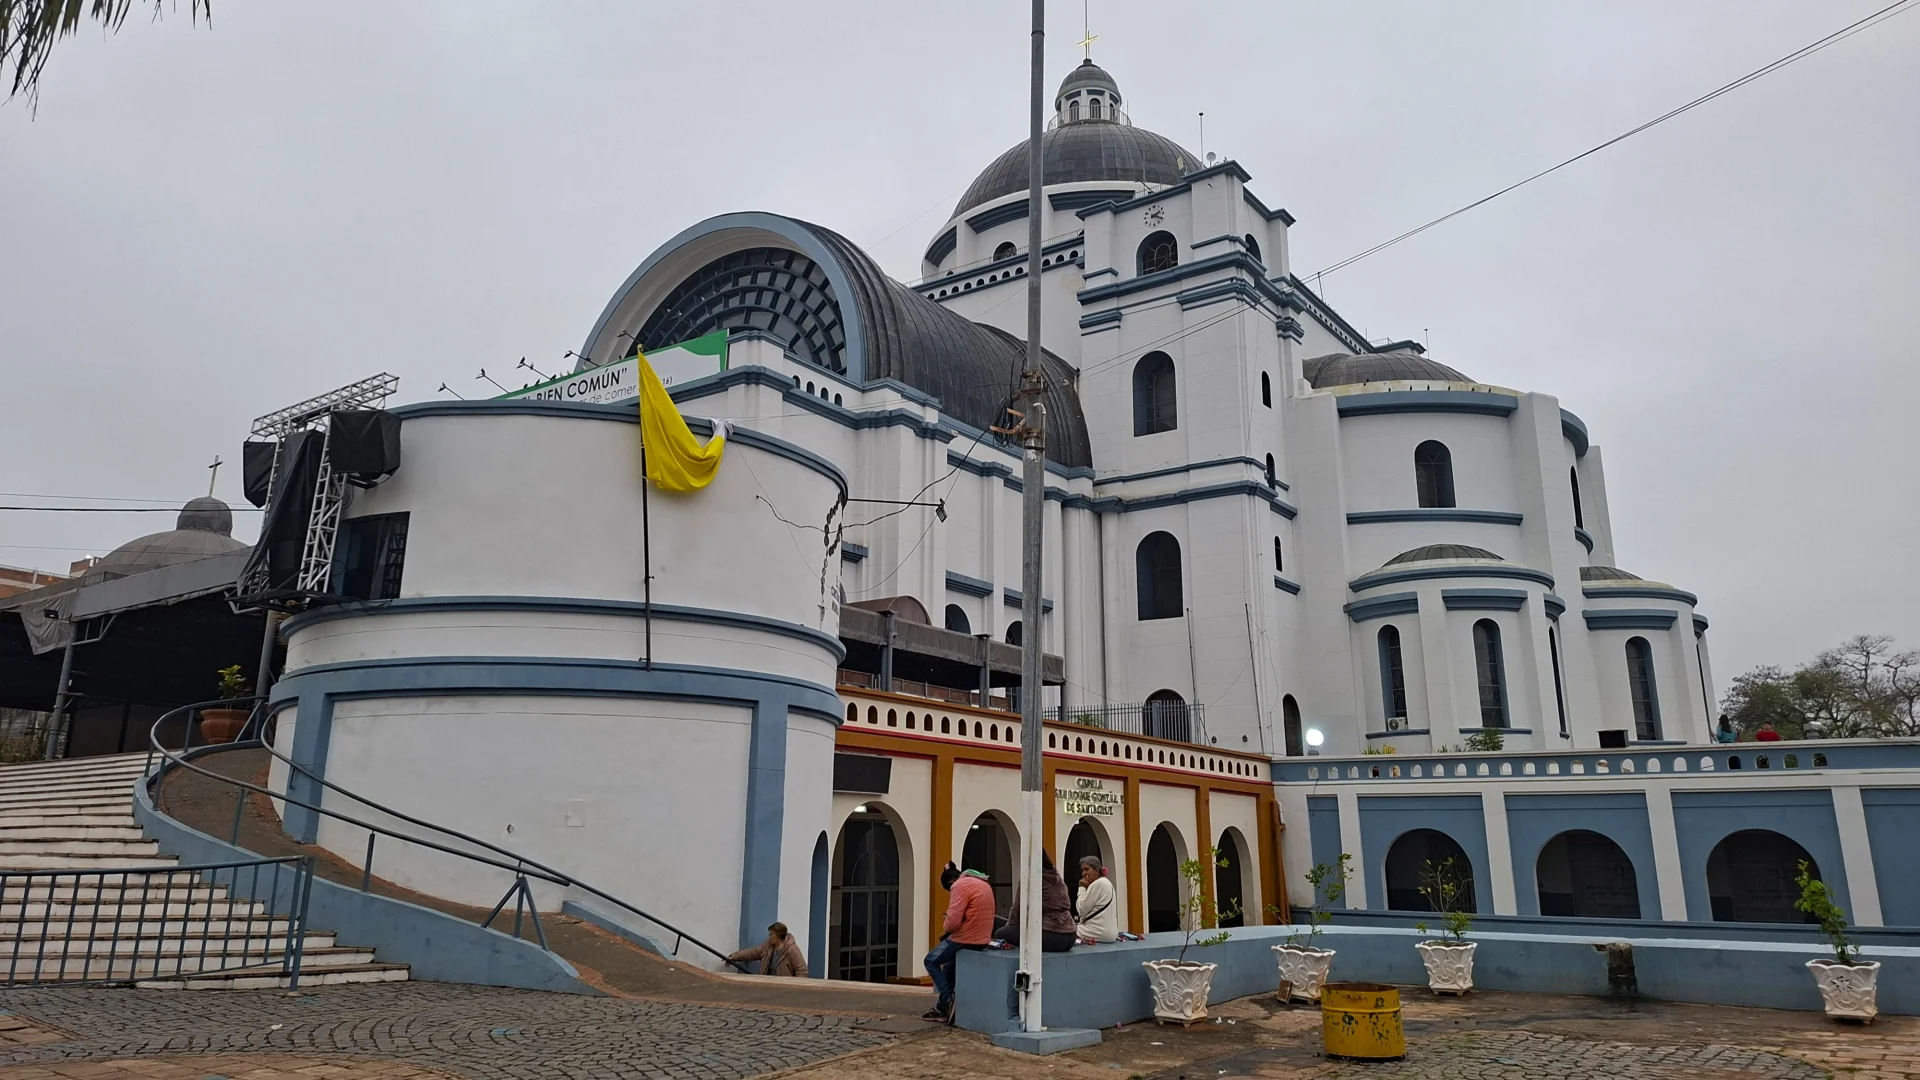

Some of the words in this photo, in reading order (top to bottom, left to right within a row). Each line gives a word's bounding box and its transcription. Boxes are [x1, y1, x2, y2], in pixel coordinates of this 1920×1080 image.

[589, 393, 602, 403] de
[604, 384, 637, 401] comer
[1066, 802, 1075, 813] DE
